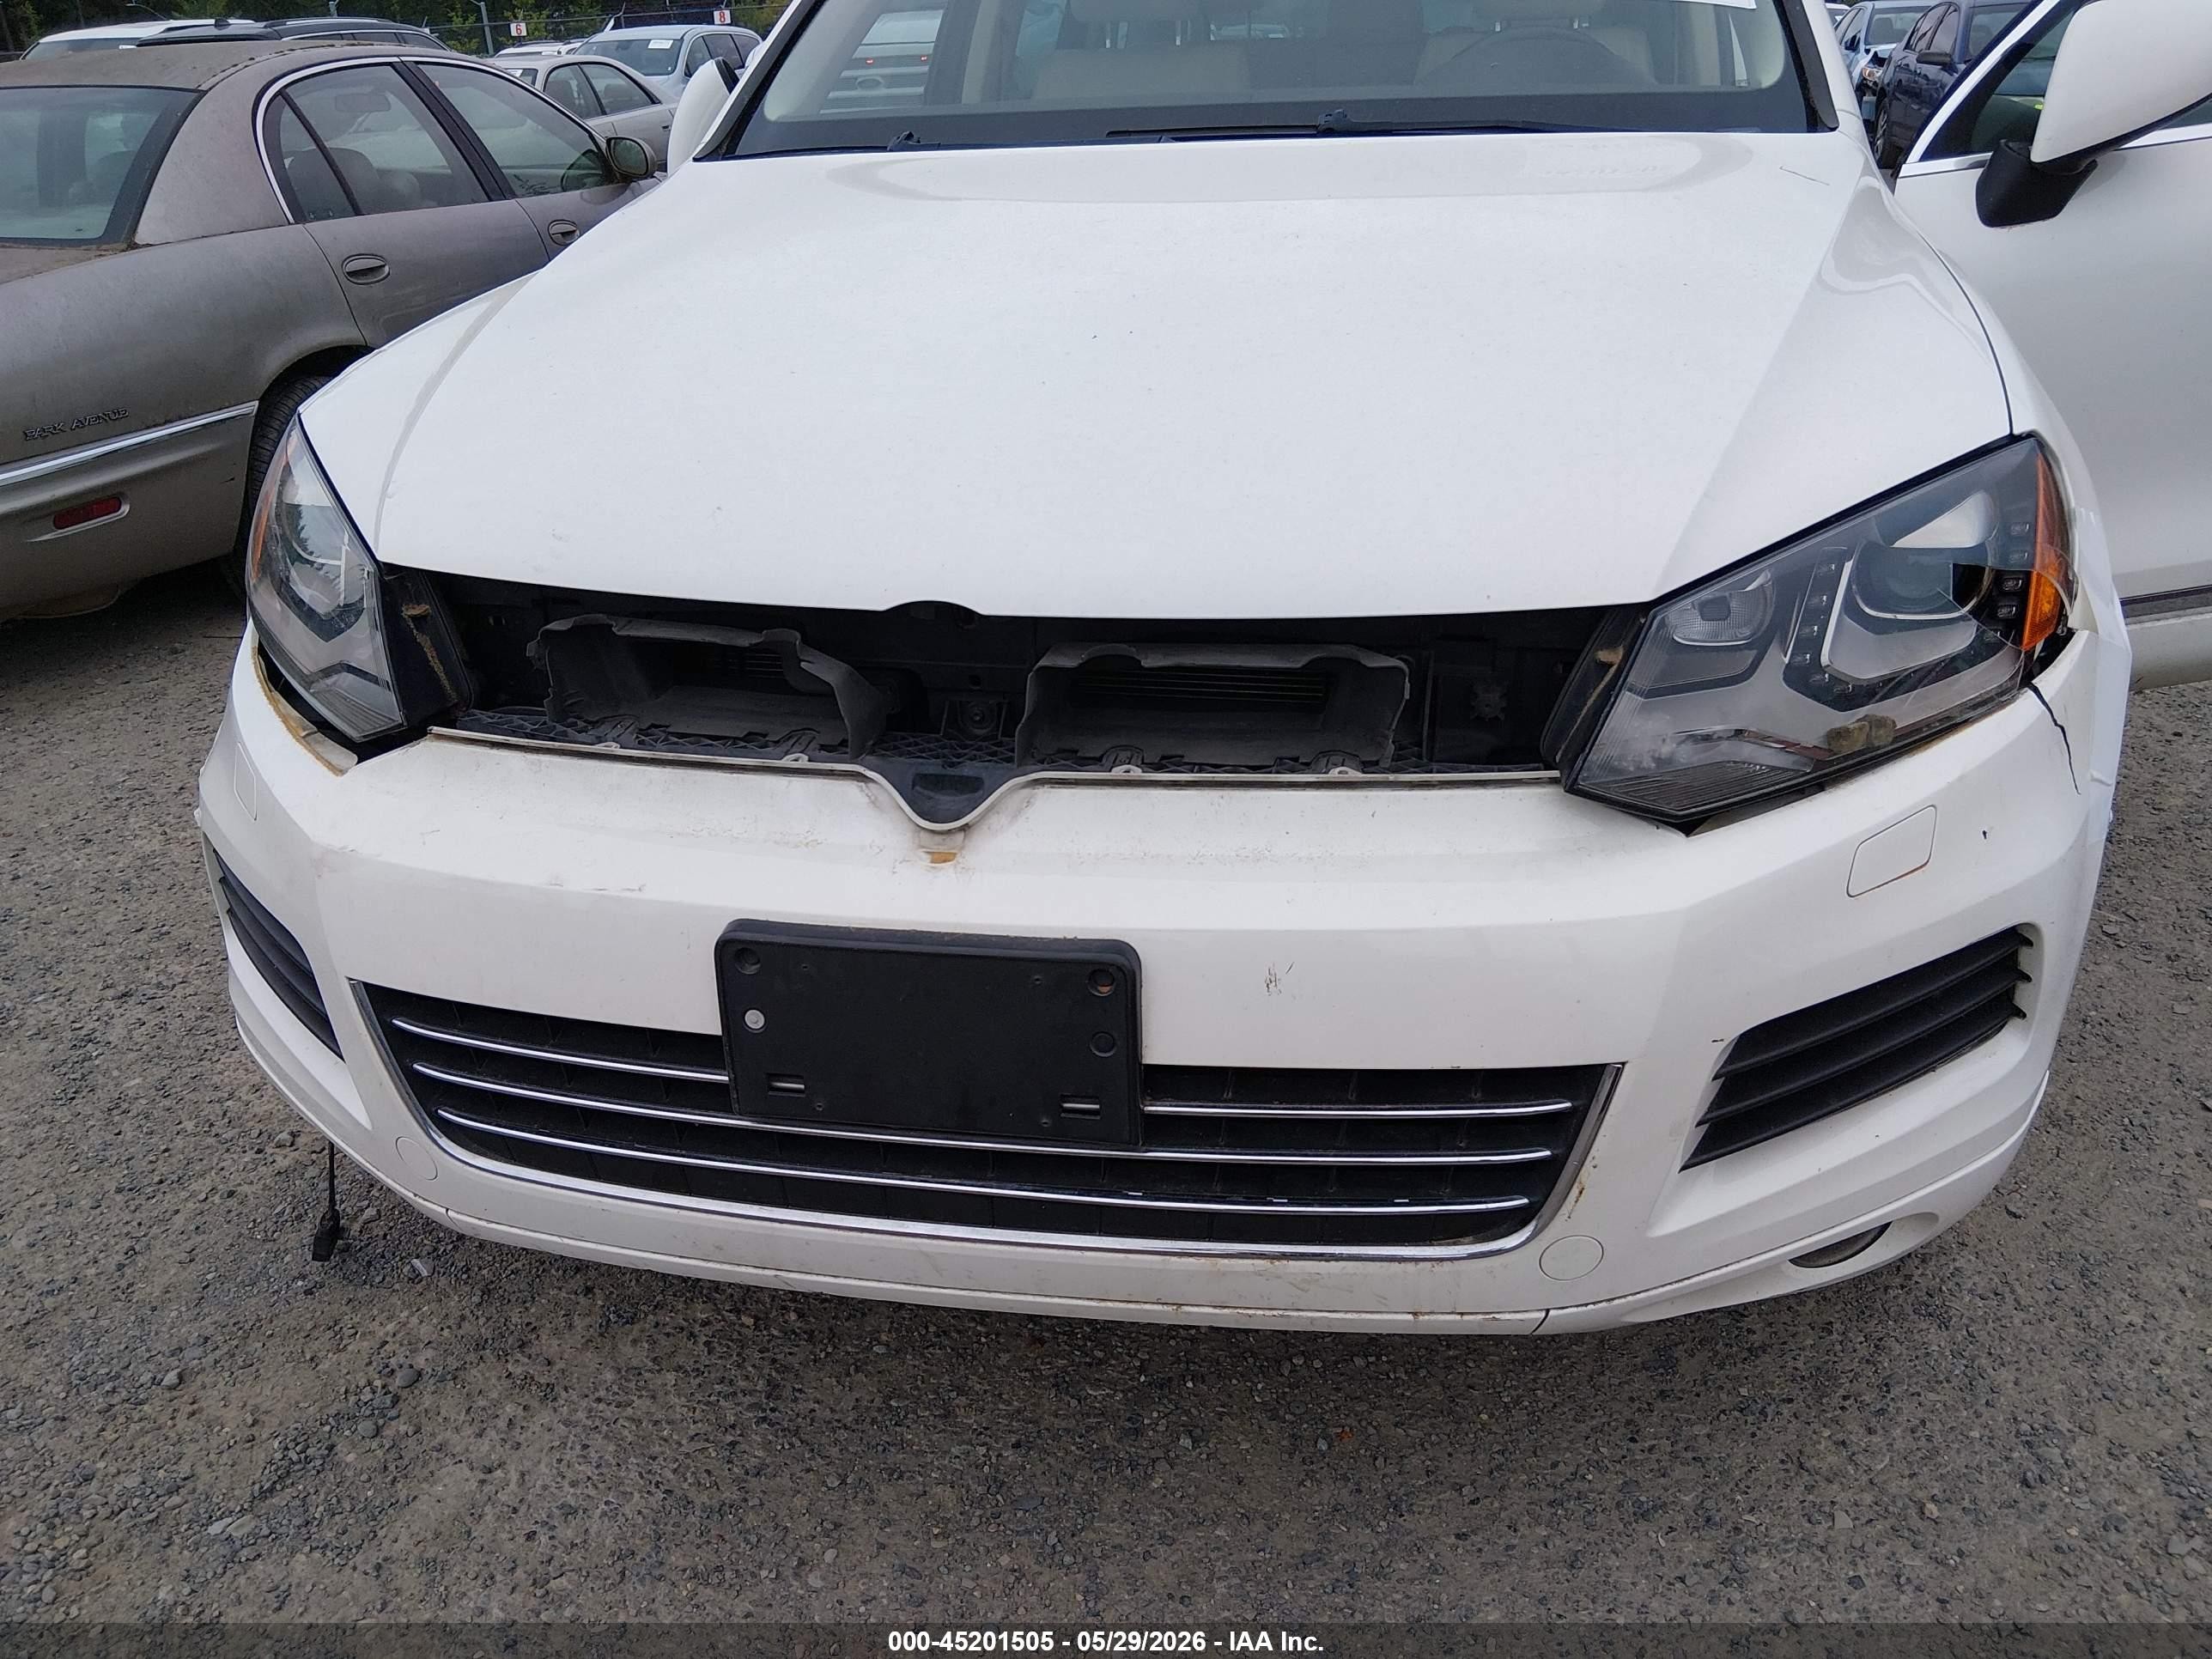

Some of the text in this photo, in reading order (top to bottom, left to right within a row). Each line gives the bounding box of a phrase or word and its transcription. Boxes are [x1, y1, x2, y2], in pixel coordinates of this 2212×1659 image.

[719, 11, 726, 22] 8
[515, 23, 522, 35] 6
[24, 408, 129, 441] PARK AVENUE
